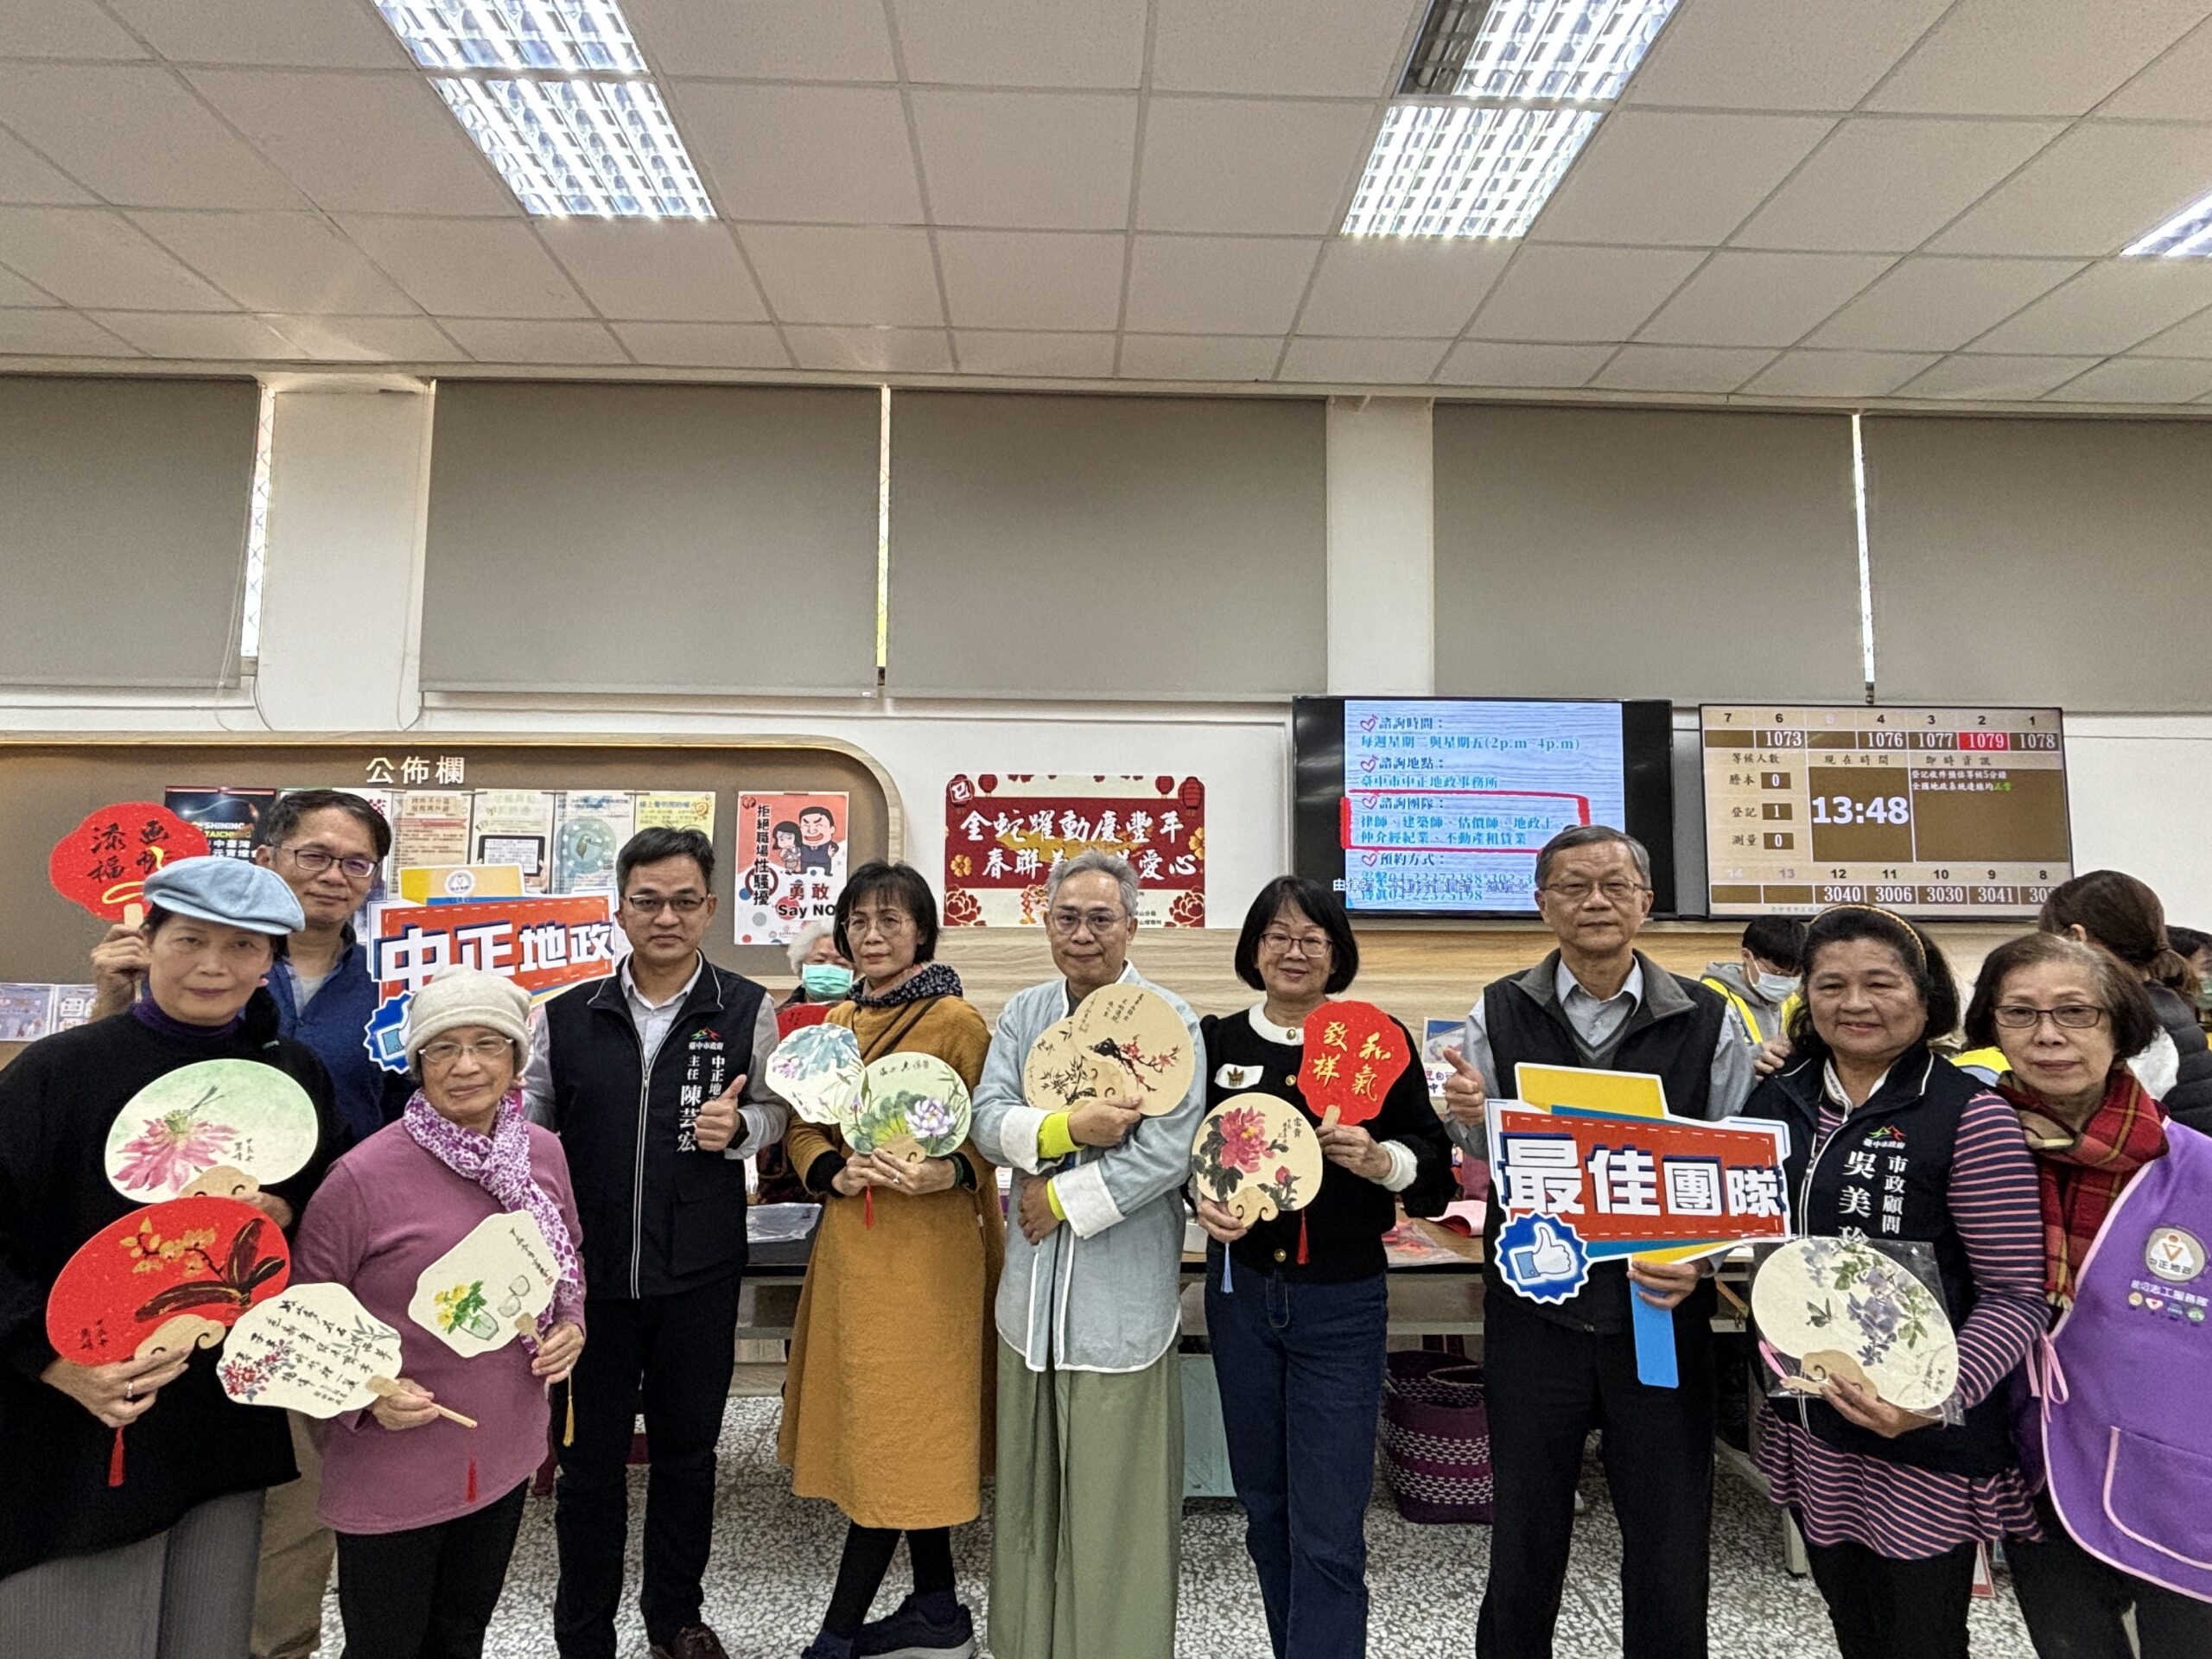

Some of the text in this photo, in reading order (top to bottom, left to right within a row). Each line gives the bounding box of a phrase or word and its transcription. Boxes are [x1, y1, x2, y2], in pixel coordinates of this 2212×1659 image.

[1724, 713, 1732, 722] 7
[1775, 713, 1784, 723] 6
[1877, 714, 1885, 724] 4
[1928, 715, 1936, 725] 3
[1978, 715, 1986, 725] 2
[2028, 715, 2036, 726] 1
[1765, 731, 2056, 748] 1073 1076 1077 1079 1078
[1732, 753, 1780, 764] 等候人數
[365, 756, 466, 785] 公佈欄
[1771, 773, 1780, 787] 0
[1731, 806, 1758, 818] 登記
[1773, 805, 1781, 818] 1
[1812, 796, 1910, 825] 13:48
[959, 809, 1185, 844] 金蛇躍動慶豐年
[1732, 834, 1758, 846] 測量
[1774, 834, 1783, 848] 0
[753, 804, 771, 906] 拒絕職場性騷擾
[982, 848, 1197, 880] 春聯愛心
[1779, 868, 1796, 879] 13
[1831, 868, 1847, 879] 12
[1882, 869, 1897, 880] 11
[1934, 870, 1949, 880] 10
[1987, 870, 1996, 880] 9
[2039, 870, 2048, 880] 8
[789, 882, 830, 901] 勇敢
[1823, 886, 2055, 904] 3040 3006 3030 3041 30
[779, 904, 836, 919] Say NO
[374, 919, 614, 992] 中正地政
[1313, 1021, 1349, 1089] 發祥
[686, 1055, 701, 1081] 主任
[1351, 1031, 1392, 1102] 和氣
[709, 1055, 726, 1101] 中正地
[1501, 1133, 1786, 1219] 最佳團隊
[1881, 1154, 1910, 1235] 市政顧問
